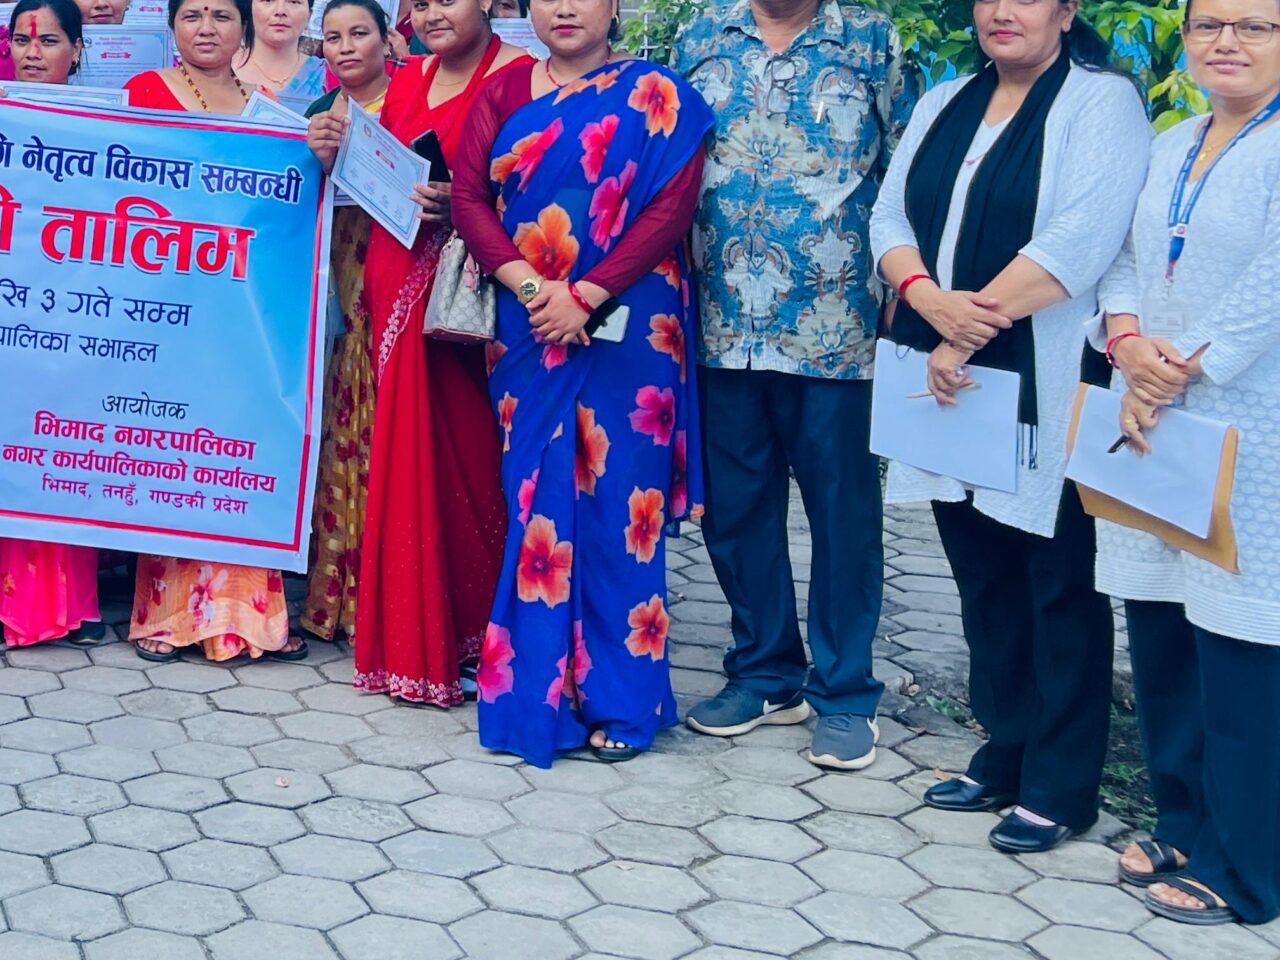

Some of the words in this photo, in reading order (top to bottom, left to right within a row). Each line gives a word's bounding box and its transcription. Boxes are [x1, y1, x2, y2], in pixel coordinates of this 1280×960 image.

[22, 136, 98, 182] नेतृत्व
[105, 144, 194, 189] विकास
[201, 164, 303, 203] सम्बन्धी
[40, 196, 255, 280] तालिम
[40, 289, 56, 313] ३
[67, 286, 113, 318] गते
[123, 298, 192, 326] सम्म
[79, 335, 159, 363] सभाहल
[102, 392, 189, 420] आयोजक
[34, 410, 107, 443] भिमाद
[114, 425, 256, 460] नगरपालिका
[2, 444, 48, 466] नगर
[52, 449, 188, 481] कार्यपालिकाको
[193, 466, 276, 493] कार्यालय
[42, 473, 91, 500] भिमाद,
[149, 490, 206, 509] गण्डकी
[213, 494, 248, 514] प्रदेश
